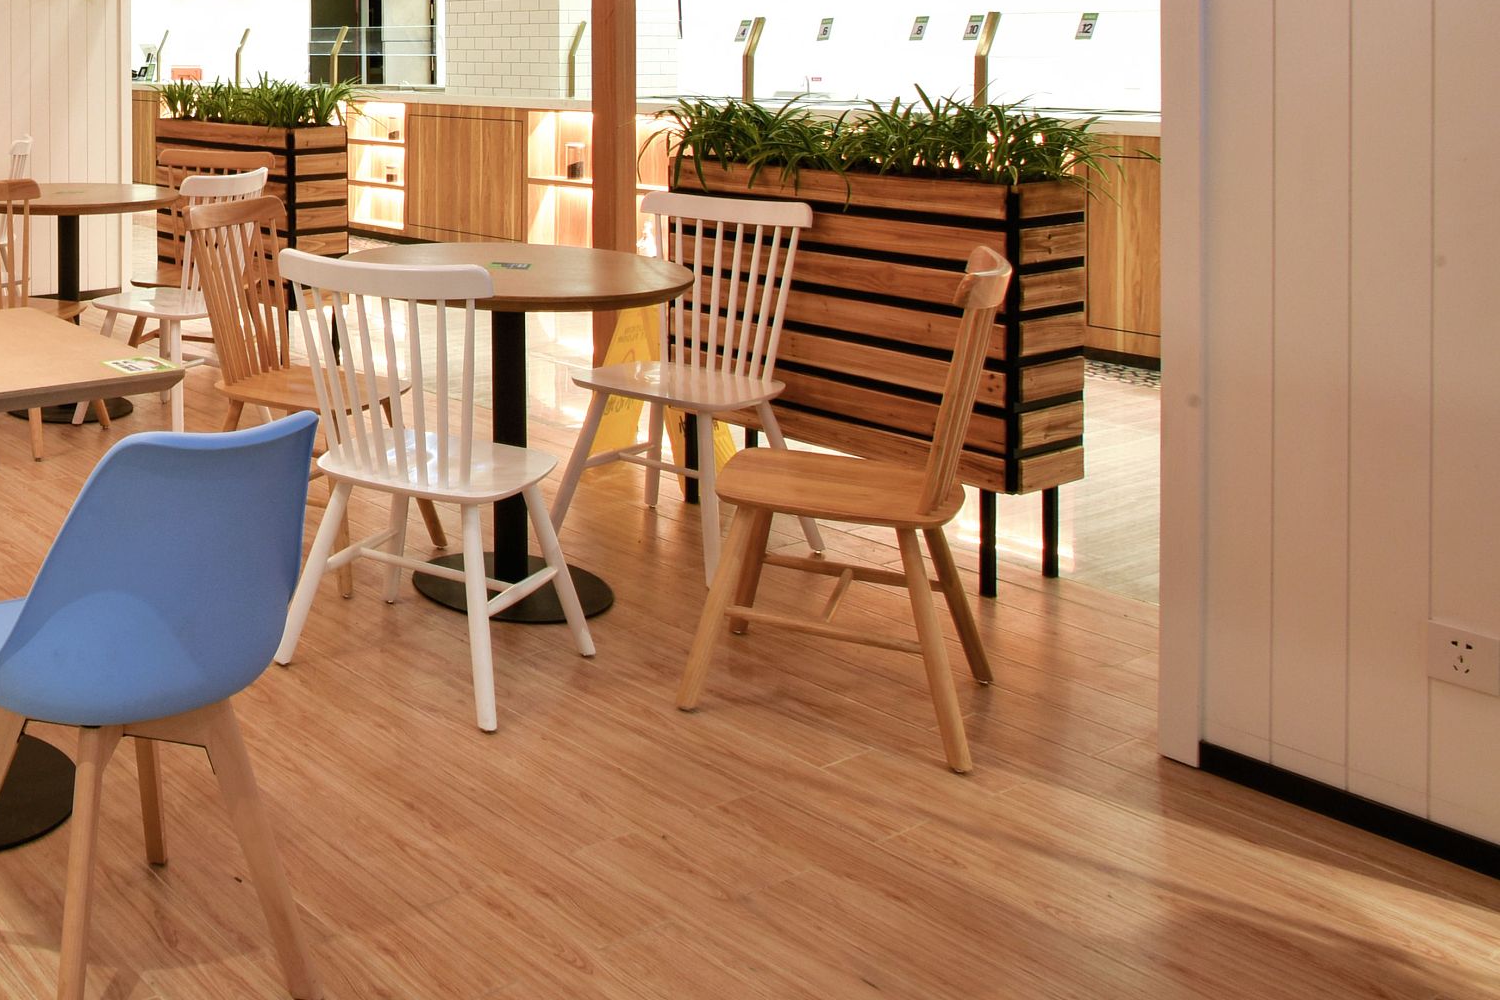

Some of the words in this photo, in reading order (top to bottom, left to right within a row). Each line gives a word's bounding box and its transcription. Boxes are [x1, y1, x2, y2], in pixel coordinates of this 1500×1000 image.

[916, 25, 924, 35] 8
[968, 24, 979, 35] 10
[1081, 23, 1093, 34] 12
